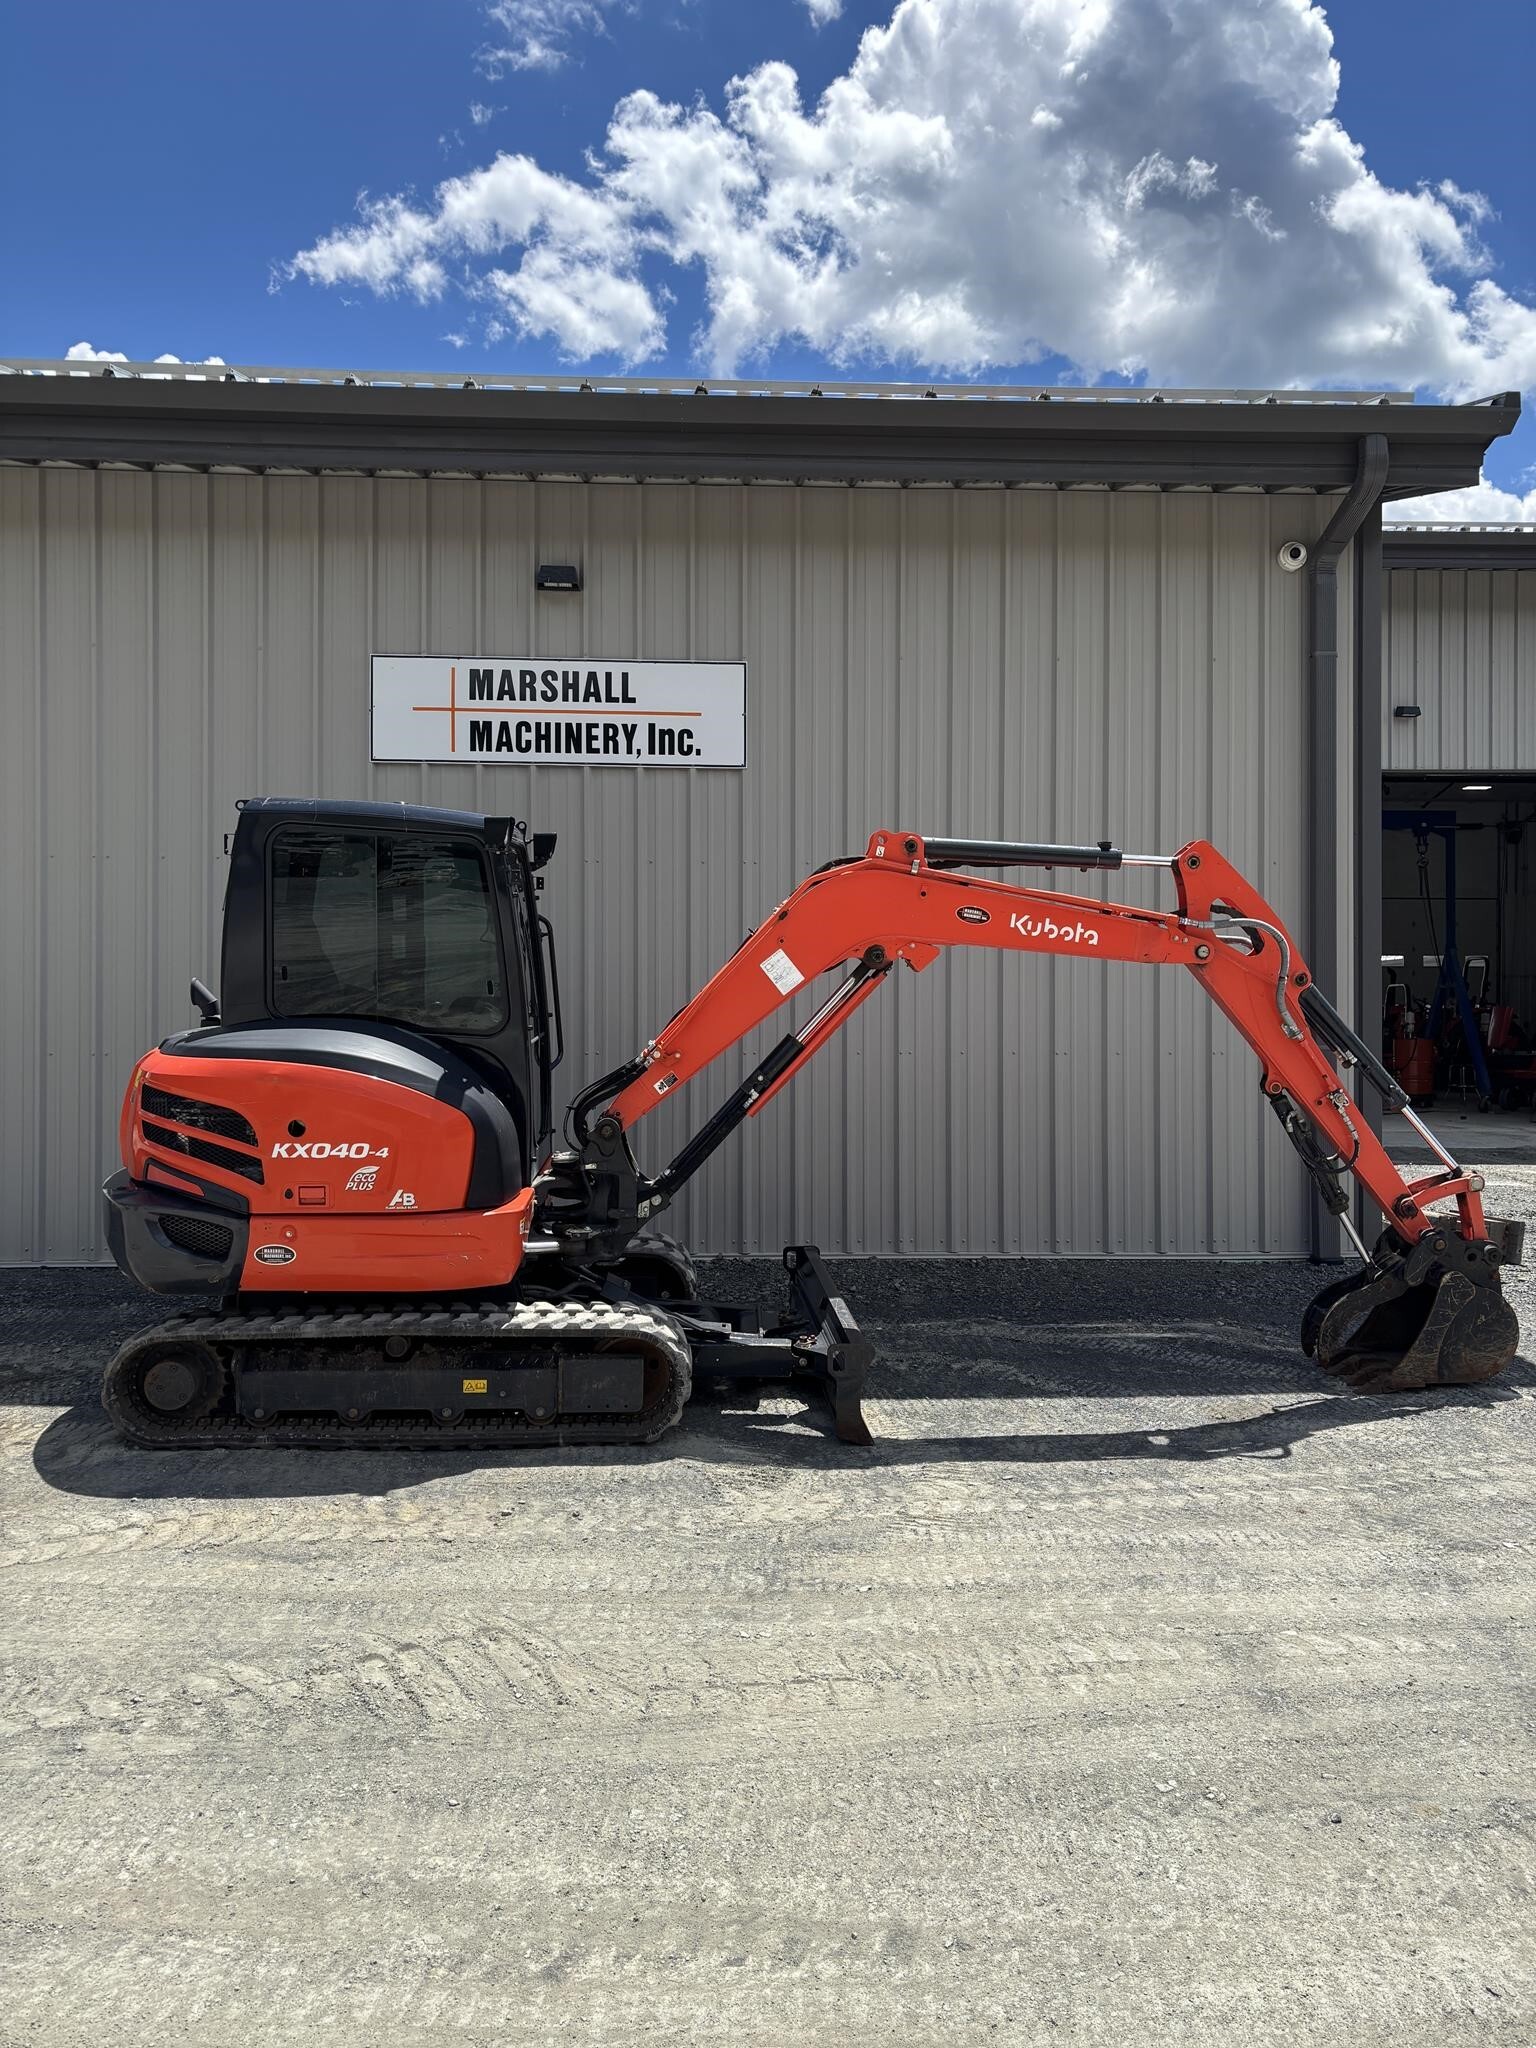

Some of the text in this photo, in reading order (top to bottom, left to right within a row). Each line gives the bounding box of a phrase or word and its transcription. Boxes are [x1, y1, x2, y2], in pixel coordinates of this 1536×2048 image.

[469, 668, 637, 703] MARSHALL
[469, 720, 702, 759] MACHINERY, Inc.
[1009, 912, 1099, 946] Kubota
[271, 1143, 389, 1159] KX040-4
[345, 1181, 375, 1191] PLUS
[354, 1173, 376, 1182] eco
